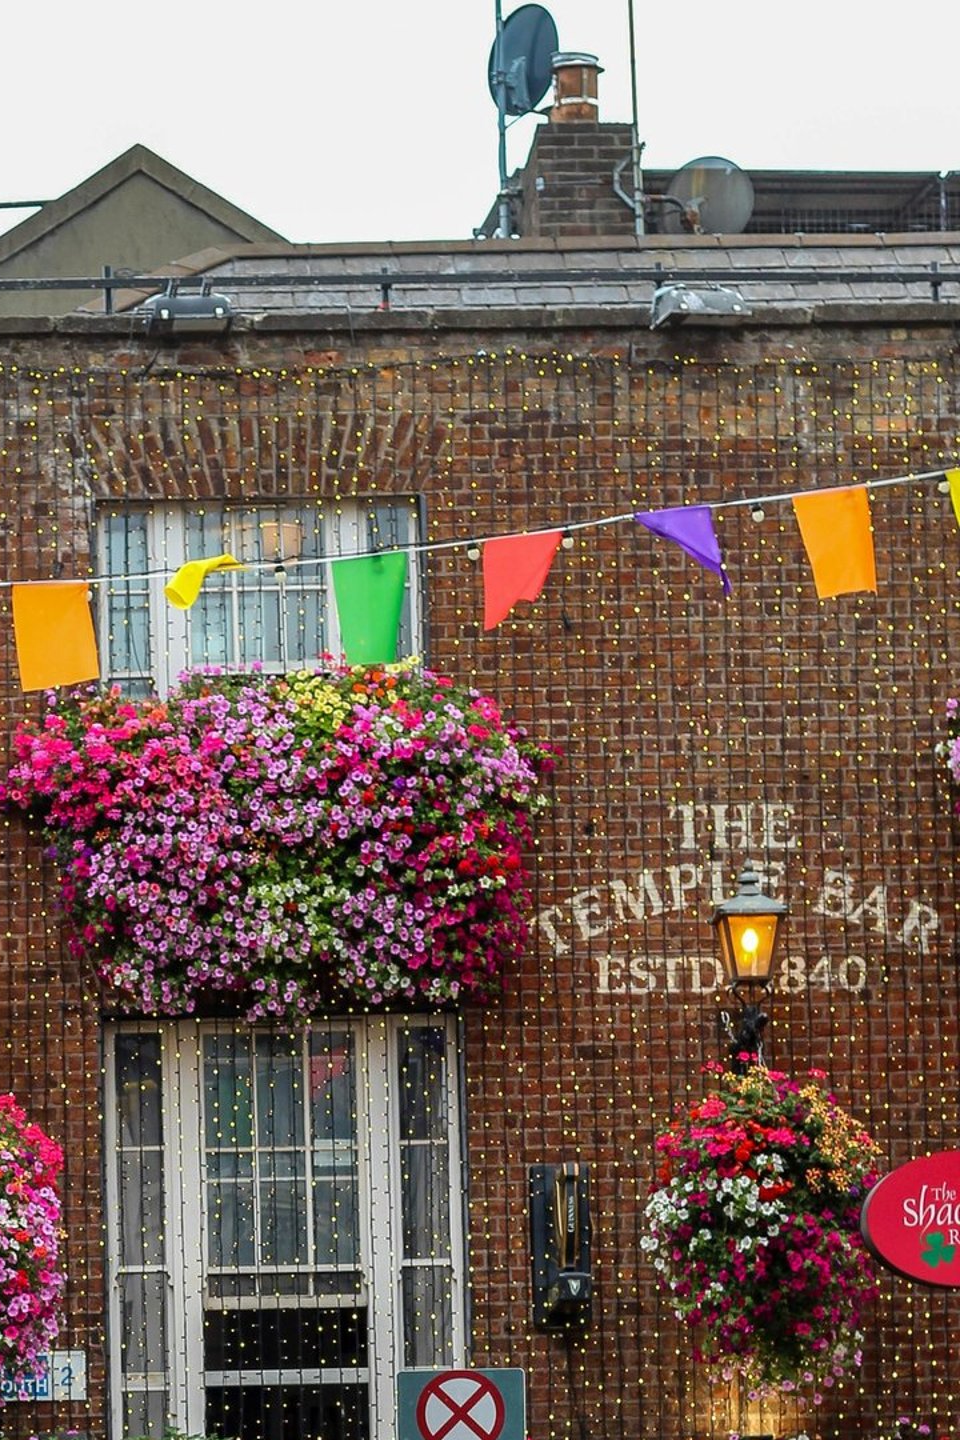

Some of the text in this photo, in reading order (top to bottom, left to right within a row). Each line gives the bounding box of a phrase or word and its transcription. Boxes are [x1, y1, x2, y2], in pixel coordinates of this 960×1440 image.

[670, 803, 796, 849] THE
[812, 869, 940, 955] BAR
[595, 955, 724, 995] ESTD
[931, 1181, 957, 1201] The
[60, 1366, 73, 1387] 2
